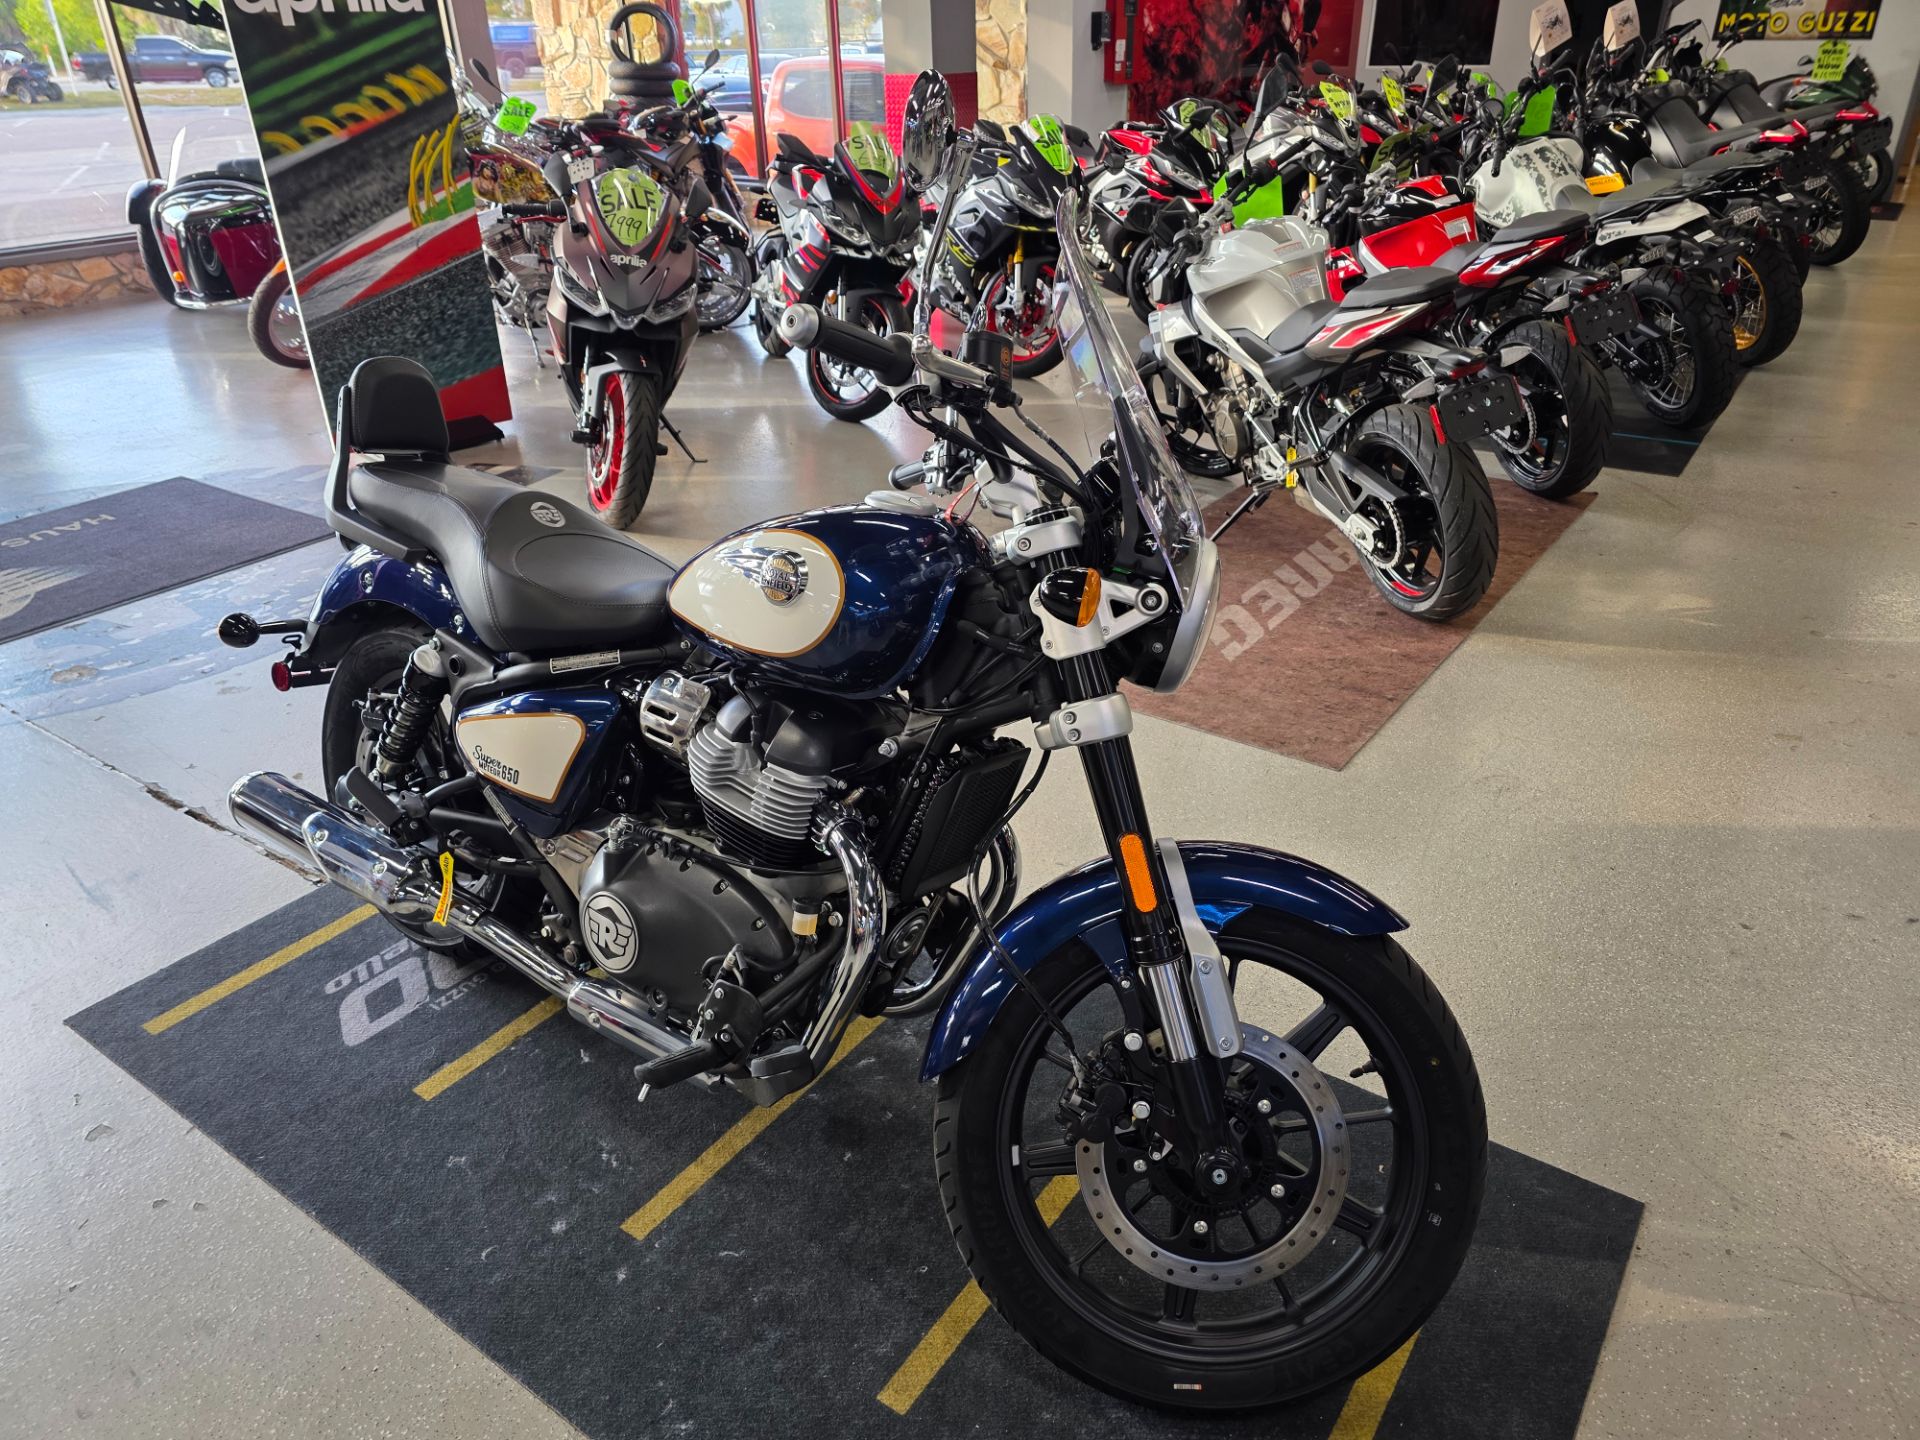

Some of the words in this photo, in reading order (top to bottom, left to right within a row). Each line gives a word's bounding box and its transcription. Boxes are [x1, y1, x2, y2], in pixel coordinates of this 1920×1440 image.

[1796, 10, 1876, 34] GUZZI
[600, 187, 658, 215] SALE
[605, 213, 643, 241] 7999
[610, 253, 648, 268] aprilia
[1, 513, 116, 548] HAUS
[472, 744, 503, 769] Super
[478, 760, 501, 778] METEOR
[501, 764, 520, 785] 650
